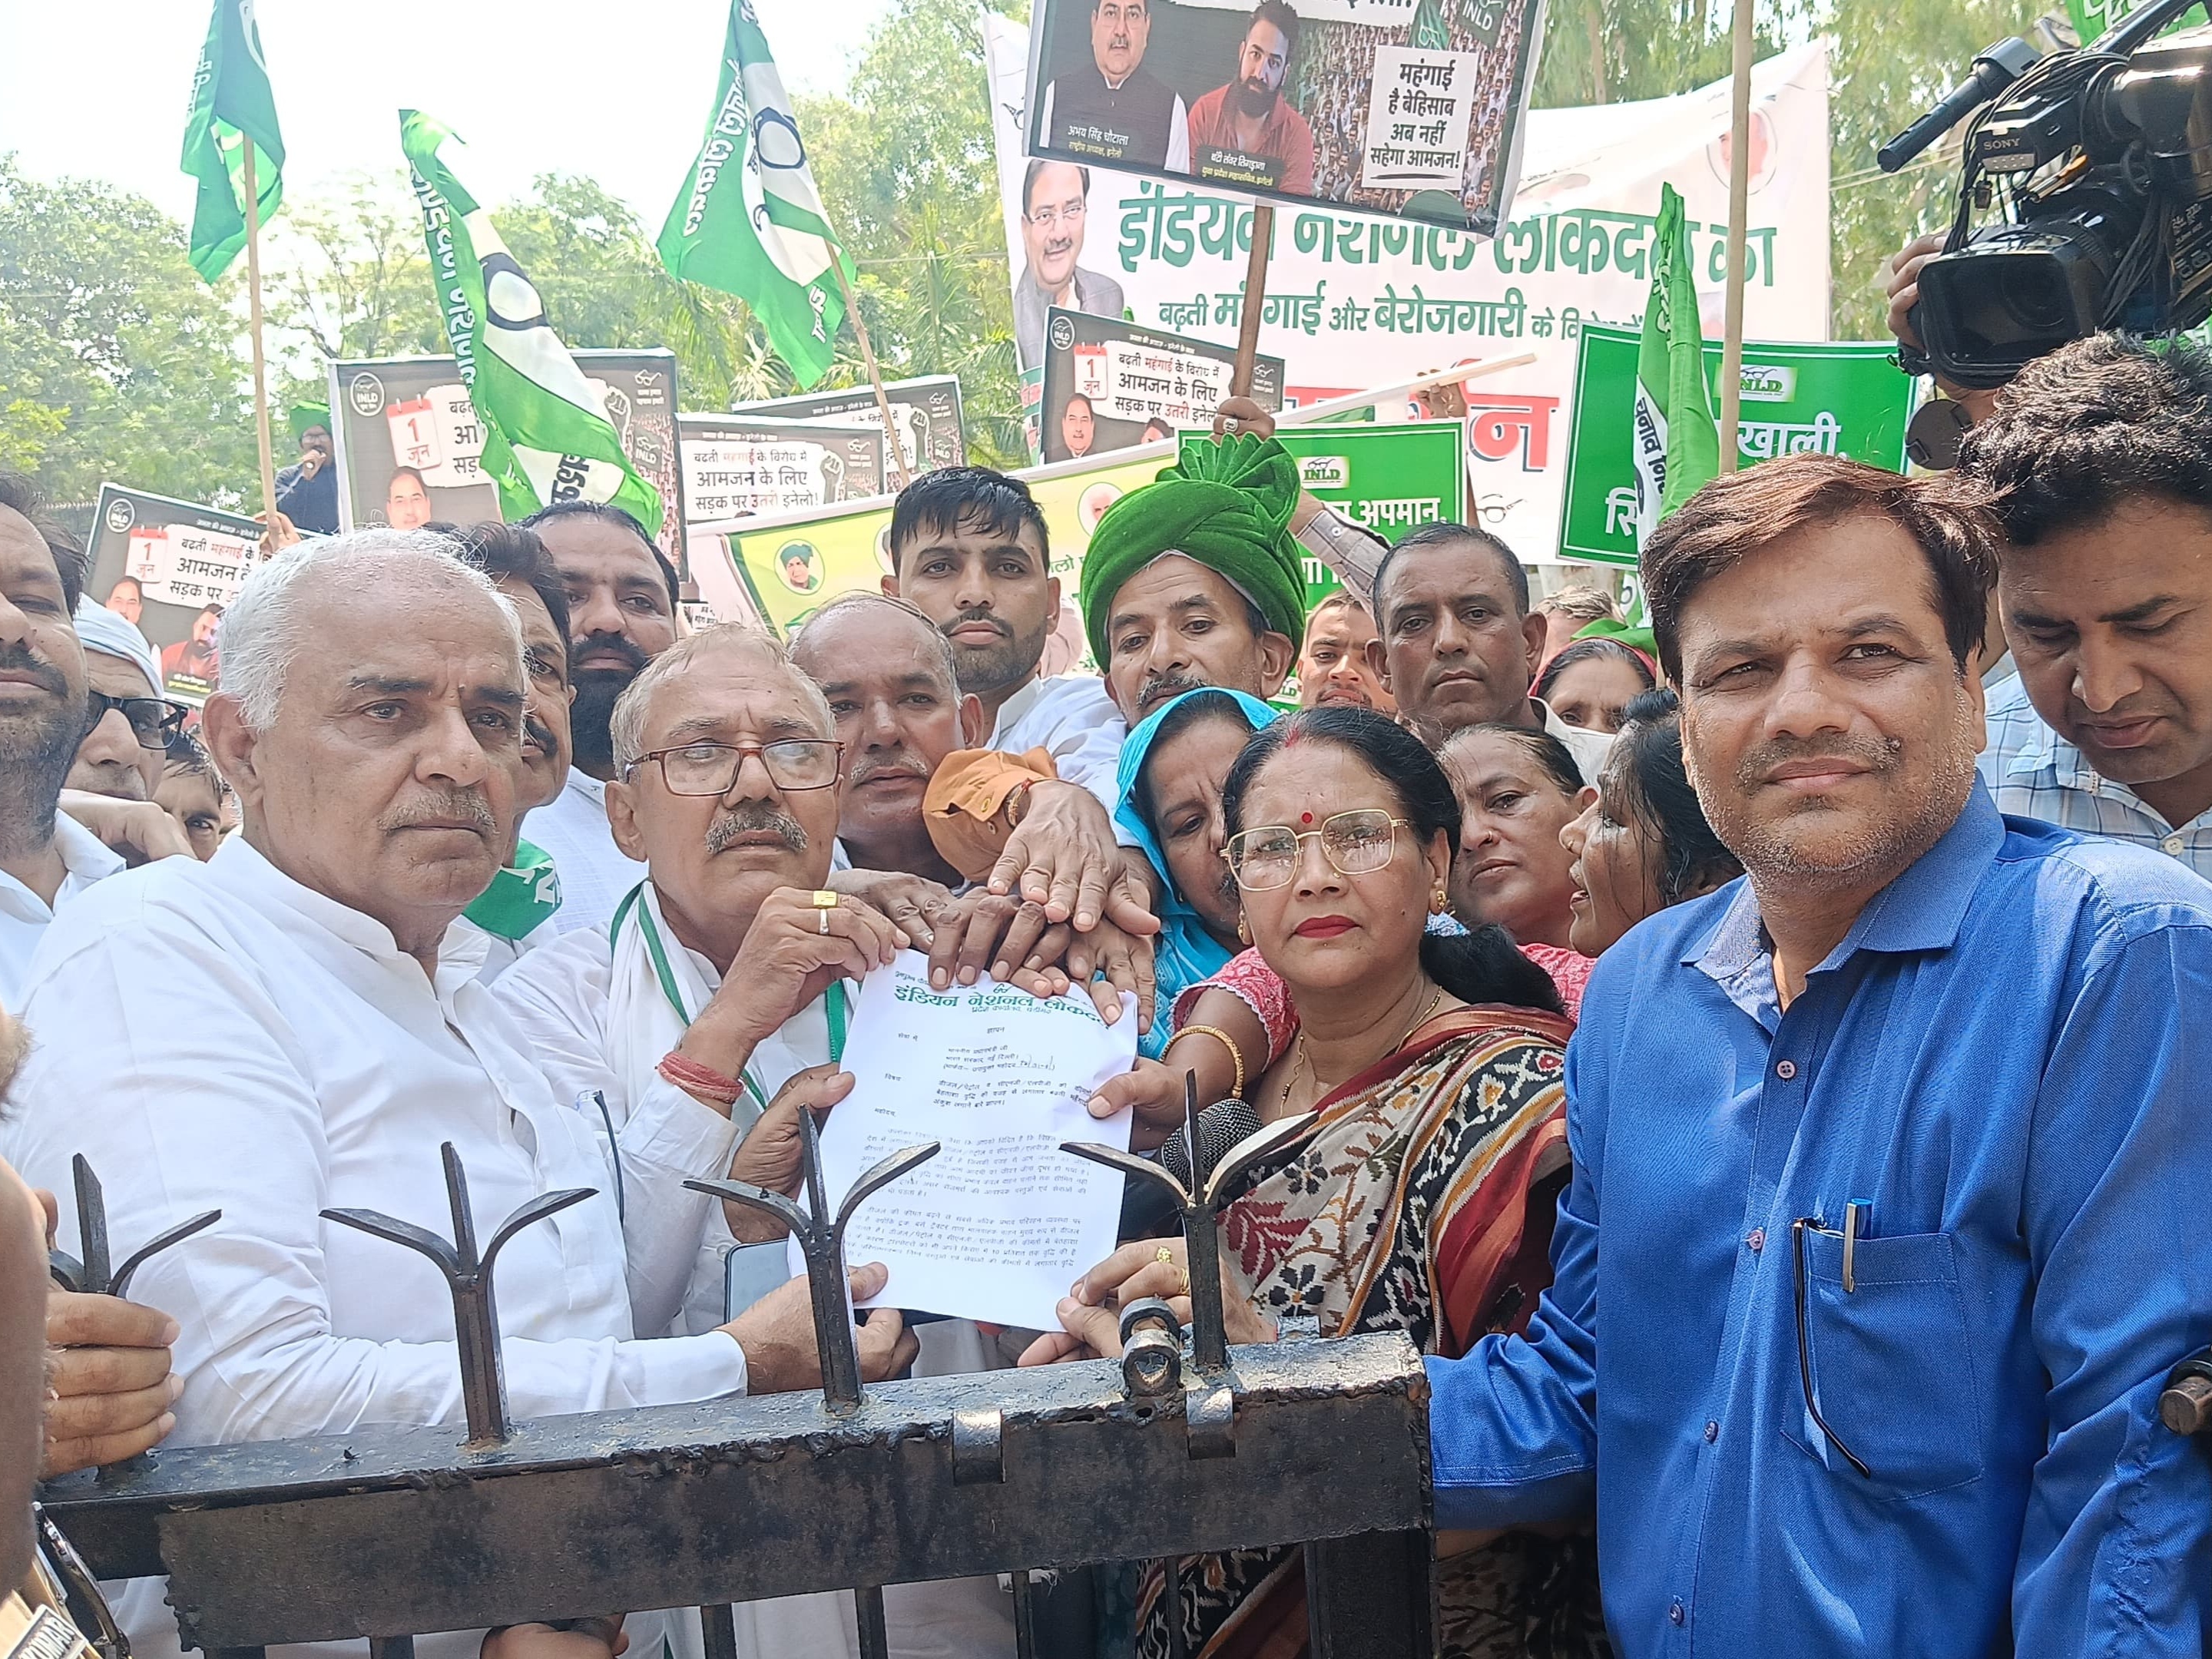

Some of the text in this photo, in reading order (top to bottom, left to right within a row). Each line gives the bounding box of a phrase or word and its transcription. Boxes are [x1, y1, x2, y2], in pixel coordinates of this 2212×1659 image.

[1462, 2, 1492, 31] INLD
[1399, 58, 1456, 91] महंगाई
[1389, 88, 1456, 117] है बेहिसाब
[1068, 125, 1129, 146] अभय सिंह चौटाला
[1390, 120, 1447, 146] अब नहीं
[1983, 137, 2020, 151] SONY
[1370, 142, 1460, 169] सहेगा आमजन!
[1159, 293, 1210, 333] बढ़ती
[1214, 280, 1327, 336] मंगाई
[1329, 296, 1371, 332] और
[1373, 283, 1528, 338] बेरोजगारी
[1531, 306, 1555, 339] के
[1087, 358, 1094, 379] 1
[1118, 352, 1141, 369] बढ़ती
[1144, 355, 1174, 373] महंगाई
[1174, 359, 1184, 373] के
[1083, 379, 1100, 394] जून
[1118, 373, 1218, 402] आमजन के लिए
[1740, 377, 1783, 392] NLD
[356, 392, 379, 403] INLD
[1114, 396, 1145, 416] सड़क
[1147, 400, 1162, 416] पर
[1164, 401, 1190, 419] उतरी
[407, 417, 419, 442] 1
[407, 443, 430, 466] जून
[635, 448, 657, 464] INLD
[757, 449, 767, 462] के
[452, 455, 481, 478] सड़
[697, 465, 808, 488] आमजन के लिए
[1303, 469, 1341, 481] INLD
[695, 488, 819, 515] सड़क पर उतरी इनेलो!
[144, 541, 152, 561] 1
[180, 537, 255, 561] बढ़ती महंगाई के
[137, 563, 155, 579] जून
[177, 557, 239, 581] आमजन
[169, 579, 223, 601] सड़क पर
[894, 984, 1111, 1031] इंडियन नेशनल लोकद
